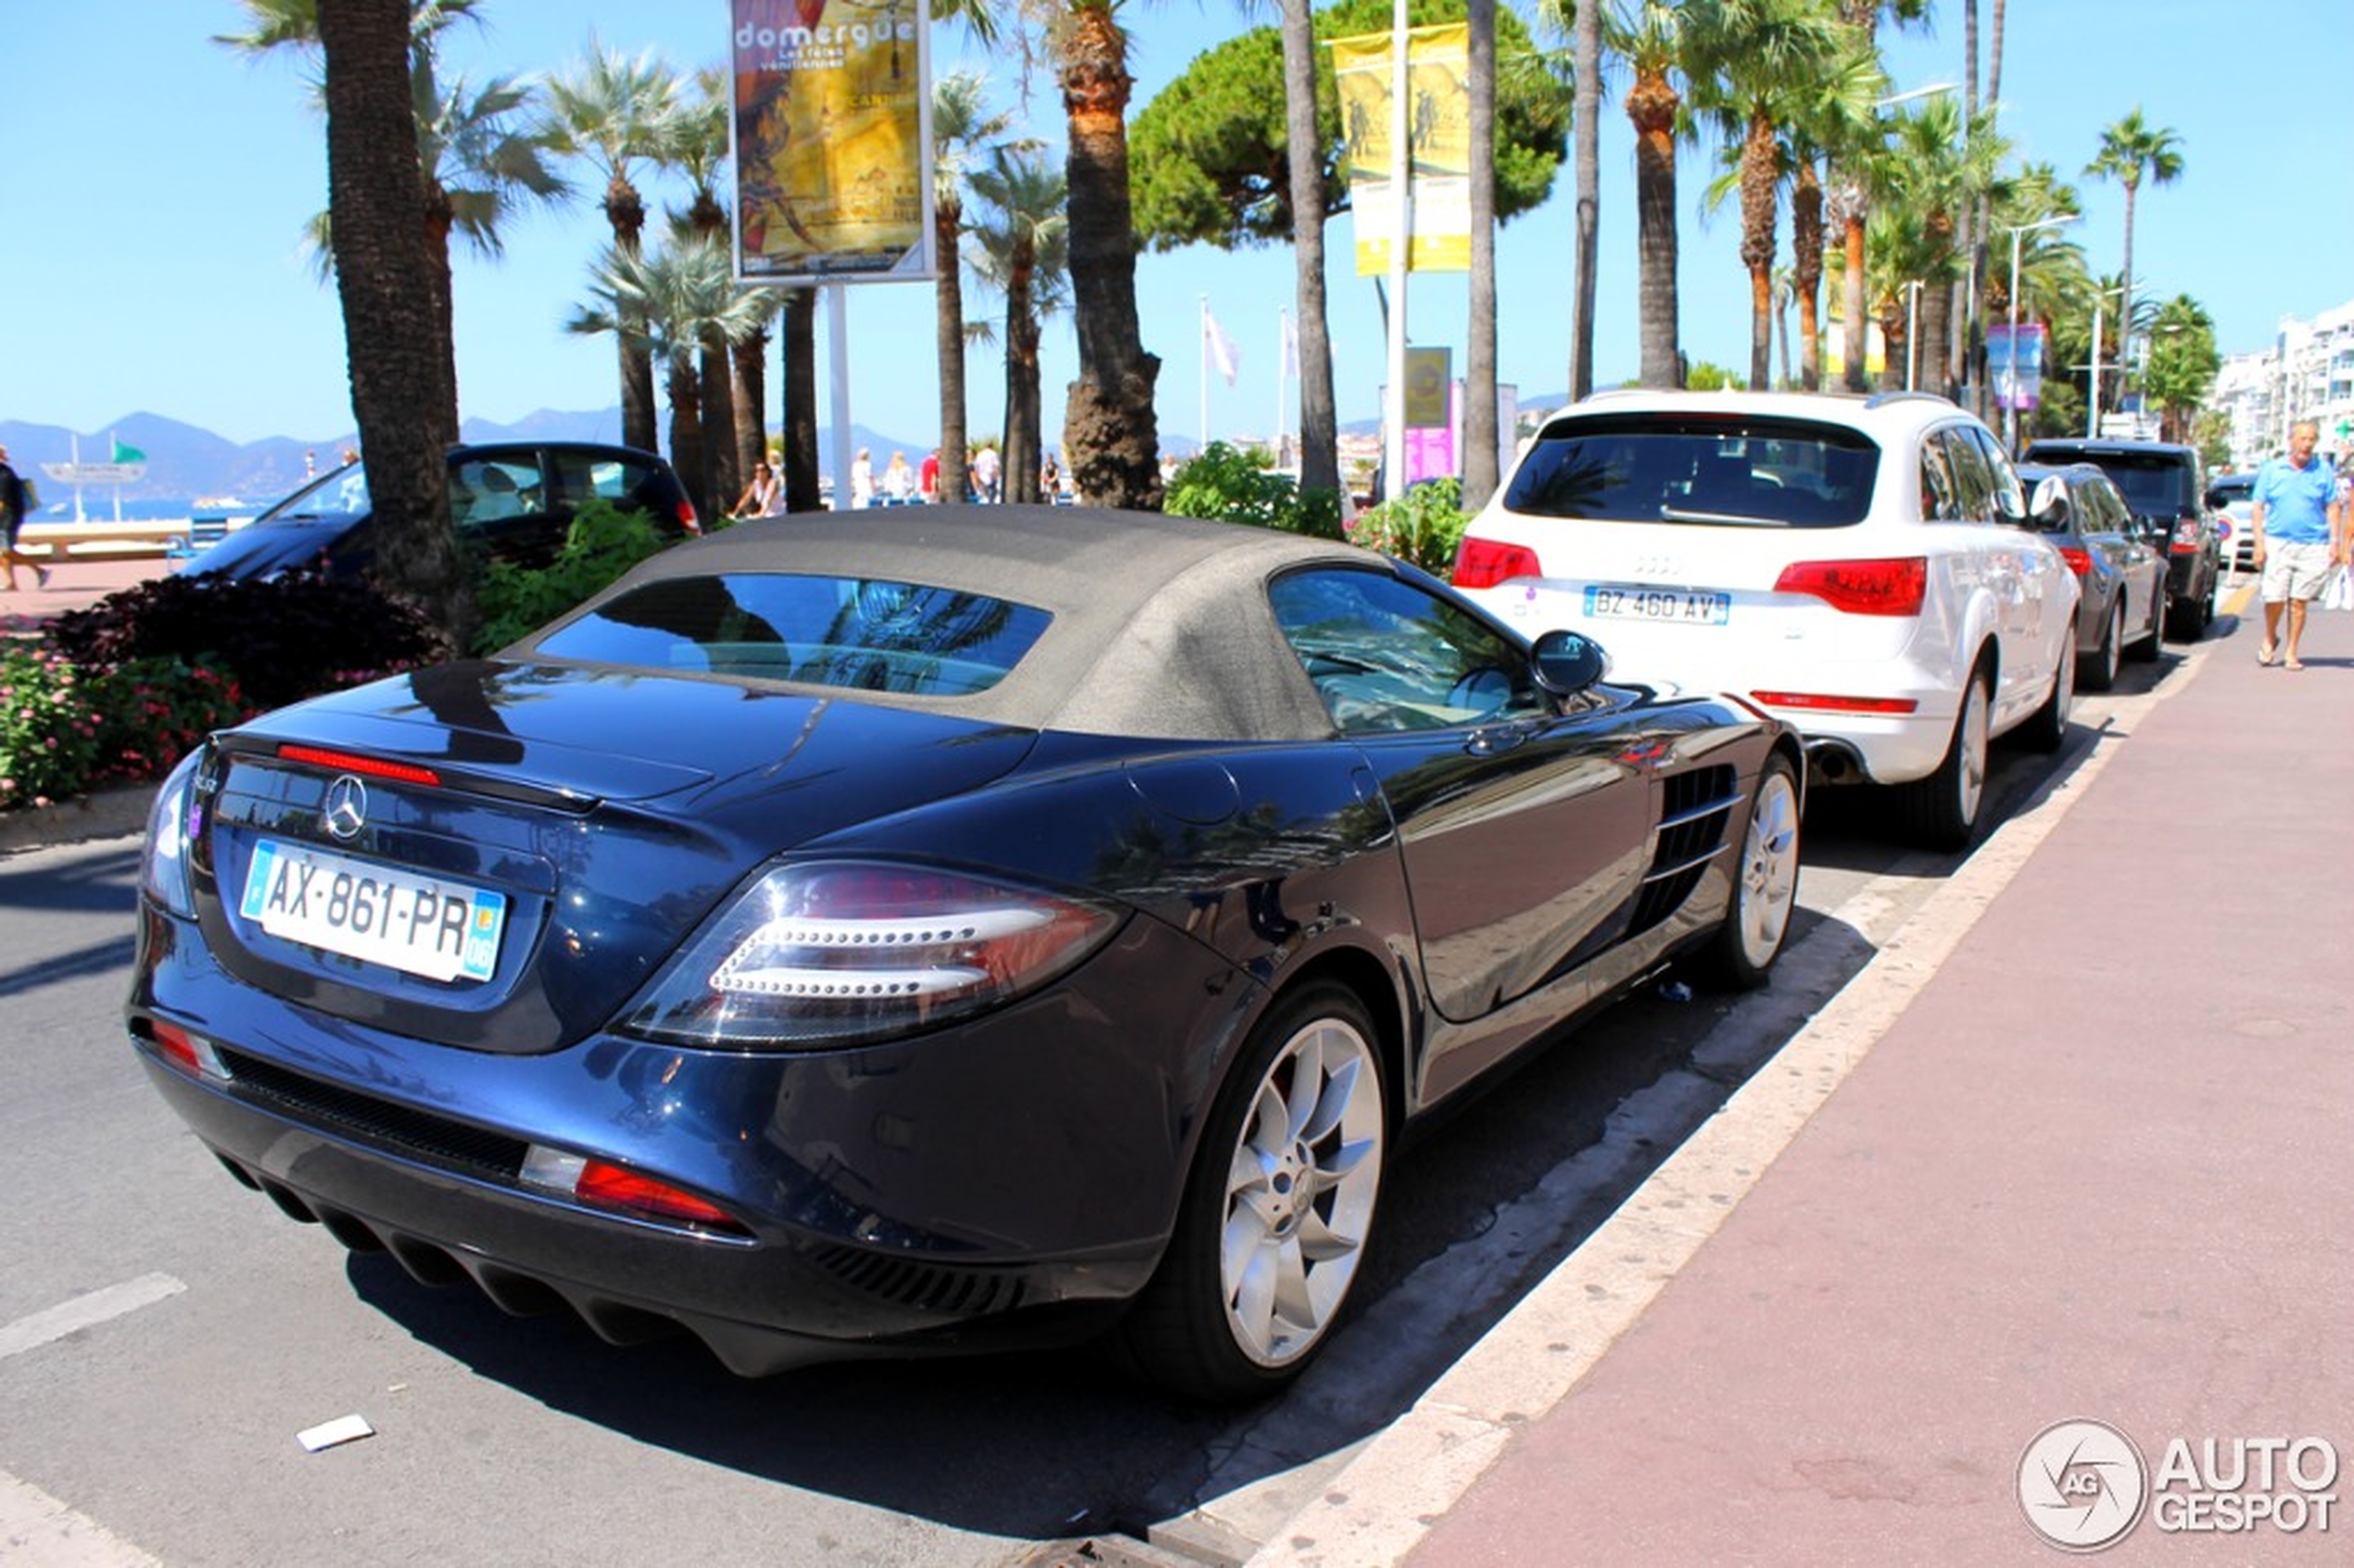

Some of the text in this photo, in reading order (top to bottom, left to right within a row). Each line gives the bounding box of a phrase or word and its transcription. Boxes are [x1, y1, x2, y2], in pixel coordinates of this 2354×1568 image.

[1596, 590, 1714, 619] BZ 460 AV
[268, 858, 469, 956] AX-861-PR
[466, 937, 489, 968] 06
